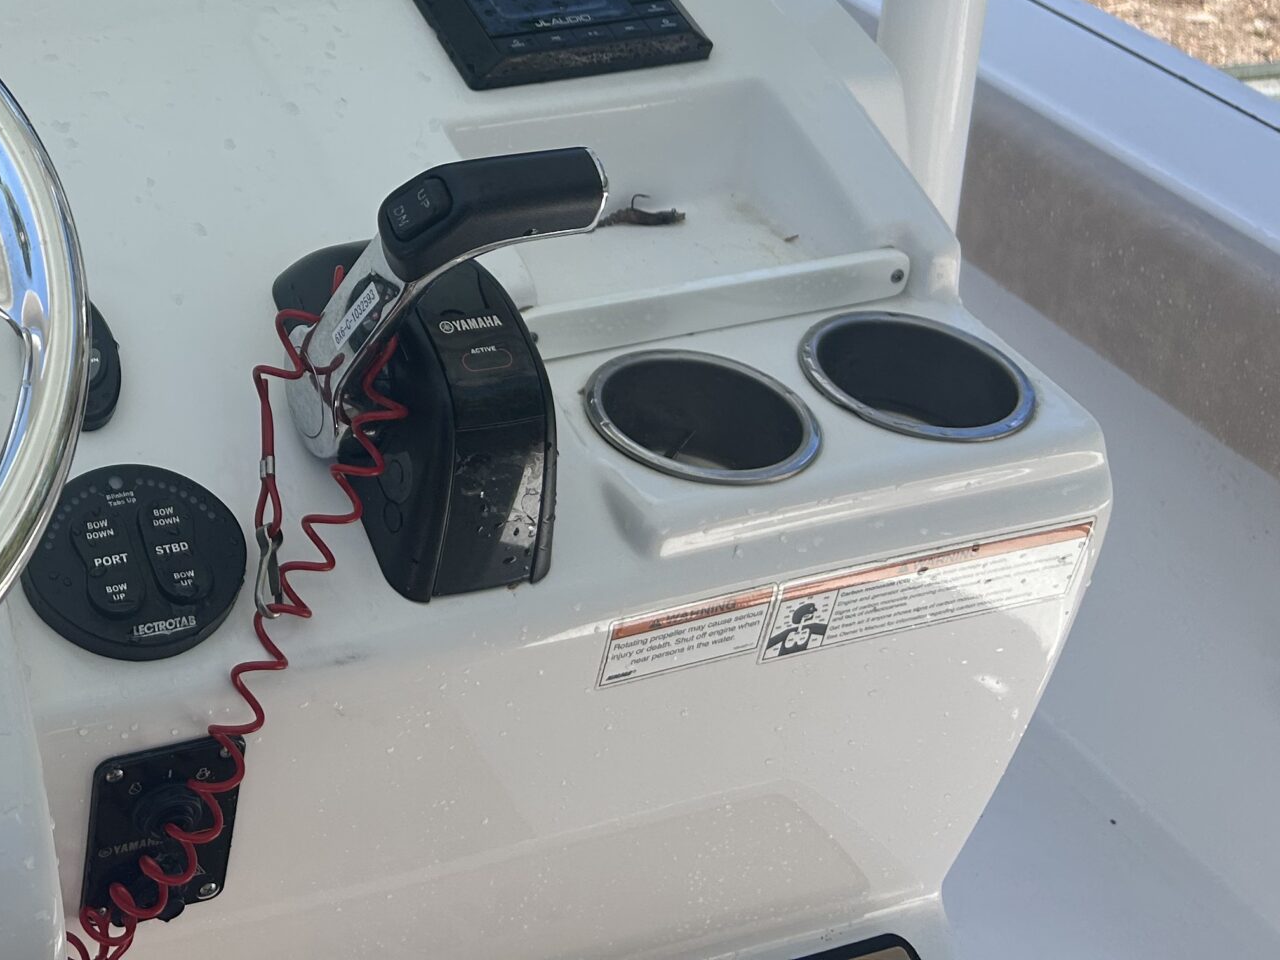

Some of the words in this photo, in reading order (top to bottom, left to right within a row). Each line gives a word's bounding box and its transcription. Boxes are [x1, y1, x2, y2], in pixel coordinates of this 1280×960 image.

[552, 14, 592, 26] AUDIO
[417, 188, 430, 208] UP
[393, 205, 409, 227] DN
[451, 315, 503, 331] YAMAHA
[470, 345, 497, 354] ACTIVE
[106, 490, 135, 501] Blinking
[108, 499, 125, 507] Tabs
[152, 506, 174, 517] BOW
[87, 518, 108, 530] BOW
[152, 515, 180, 527] DOWN
[86, 528, 115, 540] DOWN
[155, 541, 189, 555] STBD
[93, 552, 128, 567] PORT
[173, 569, 195, 580] BOW
[105, 582, 128, 594] BOW
[180, 579, 194, 587] UP
[113, 592, 126, 601] UP
[133, 615, 197, 636] LECTROTAB
[613, 638, 649, 651] Rotating
[649, 628, 687, 643] propeller
[688, 622, 706, 634] may
[707, 618, 732, 628] cause
[733, 610, 763, 621] serious
[610, 650, 635, 661] injury
[636, 648, 645, 656] or
[646, 641, 672, 652] death.
[674, 635, 695, 646] Shut
[696, 631, 707, 640] off
[707, 625, 736, 638] engine
[738, 620, 761, 630] when
[630, 655, 651, 665] near
[651, 647, 685, 661] persons
[696, 640, 710, 649] the
